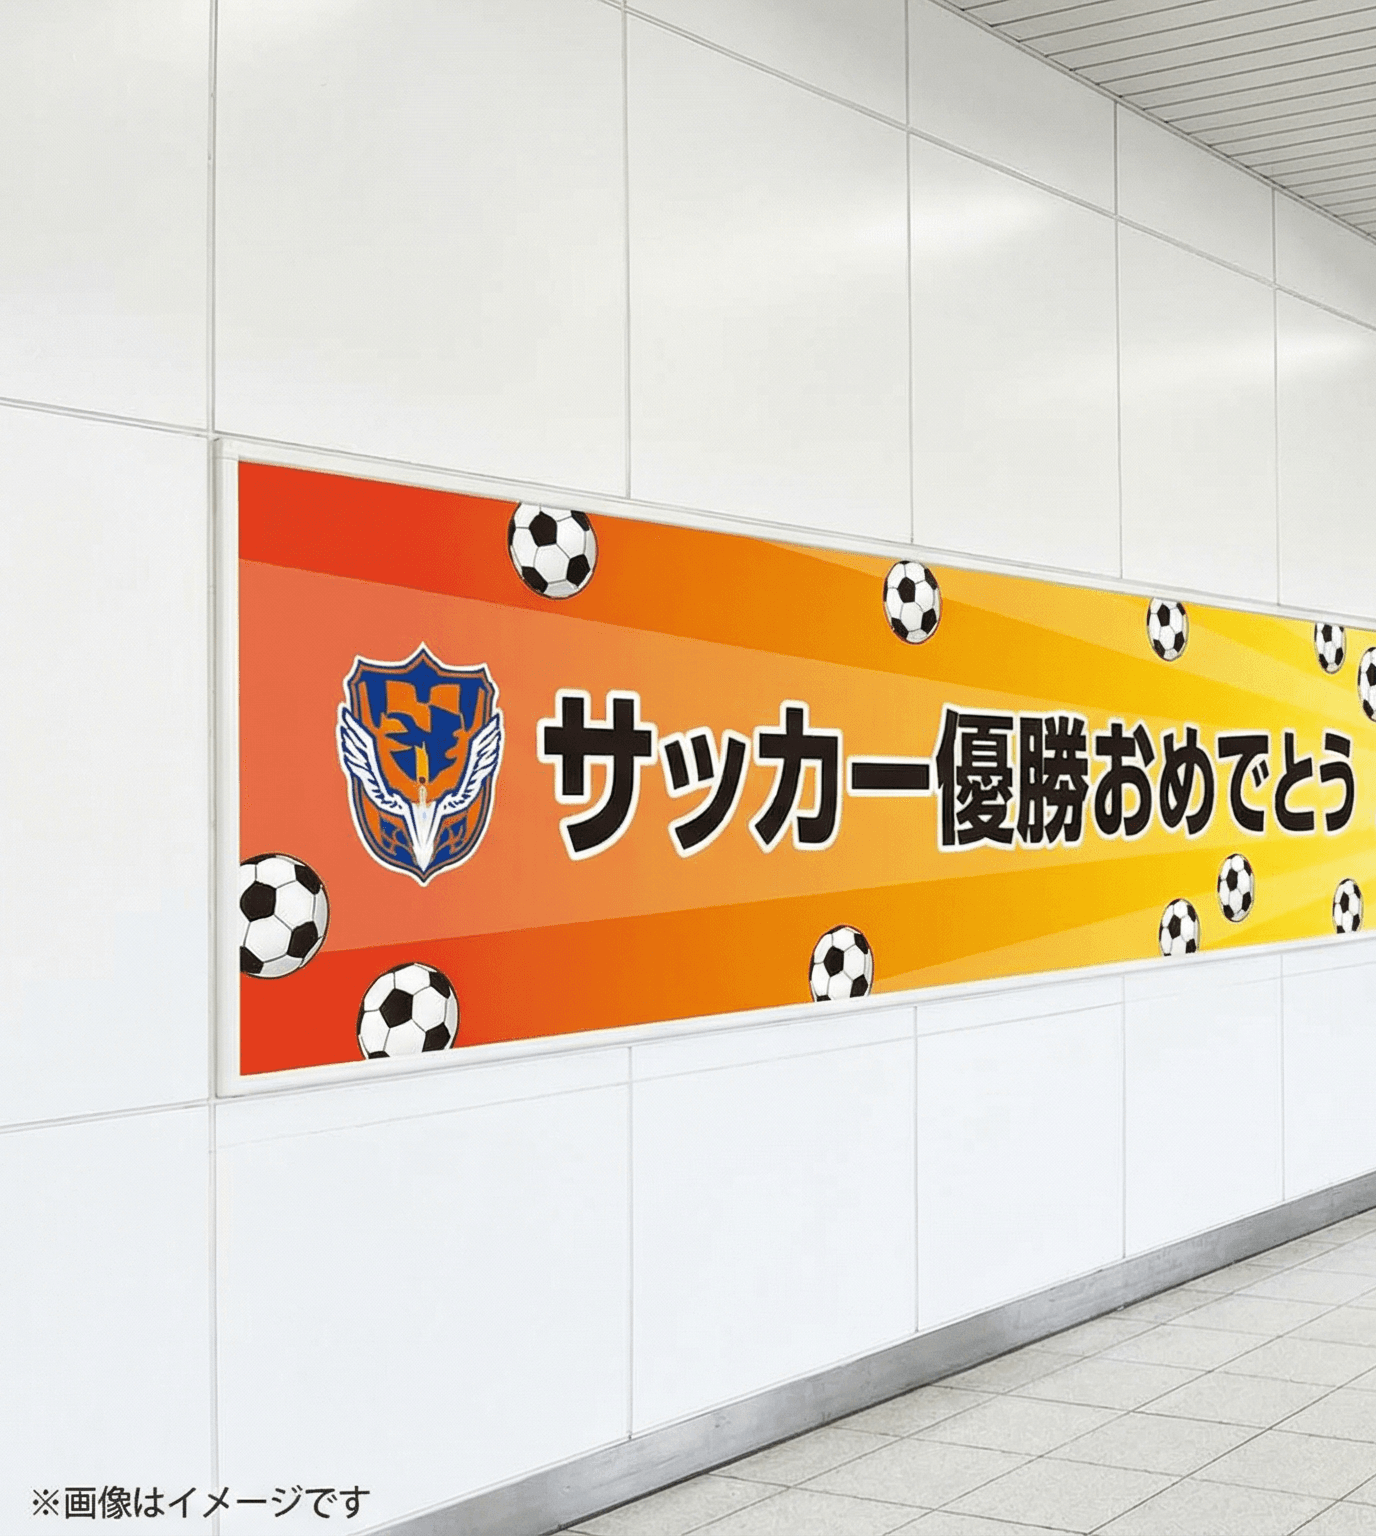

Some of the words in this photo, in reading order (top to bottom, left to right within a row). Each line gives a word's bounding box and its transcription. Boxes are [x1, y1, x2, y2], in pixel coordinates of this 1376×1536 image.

[543, 696, 1355, 854] サッカー優勝おめでとう
